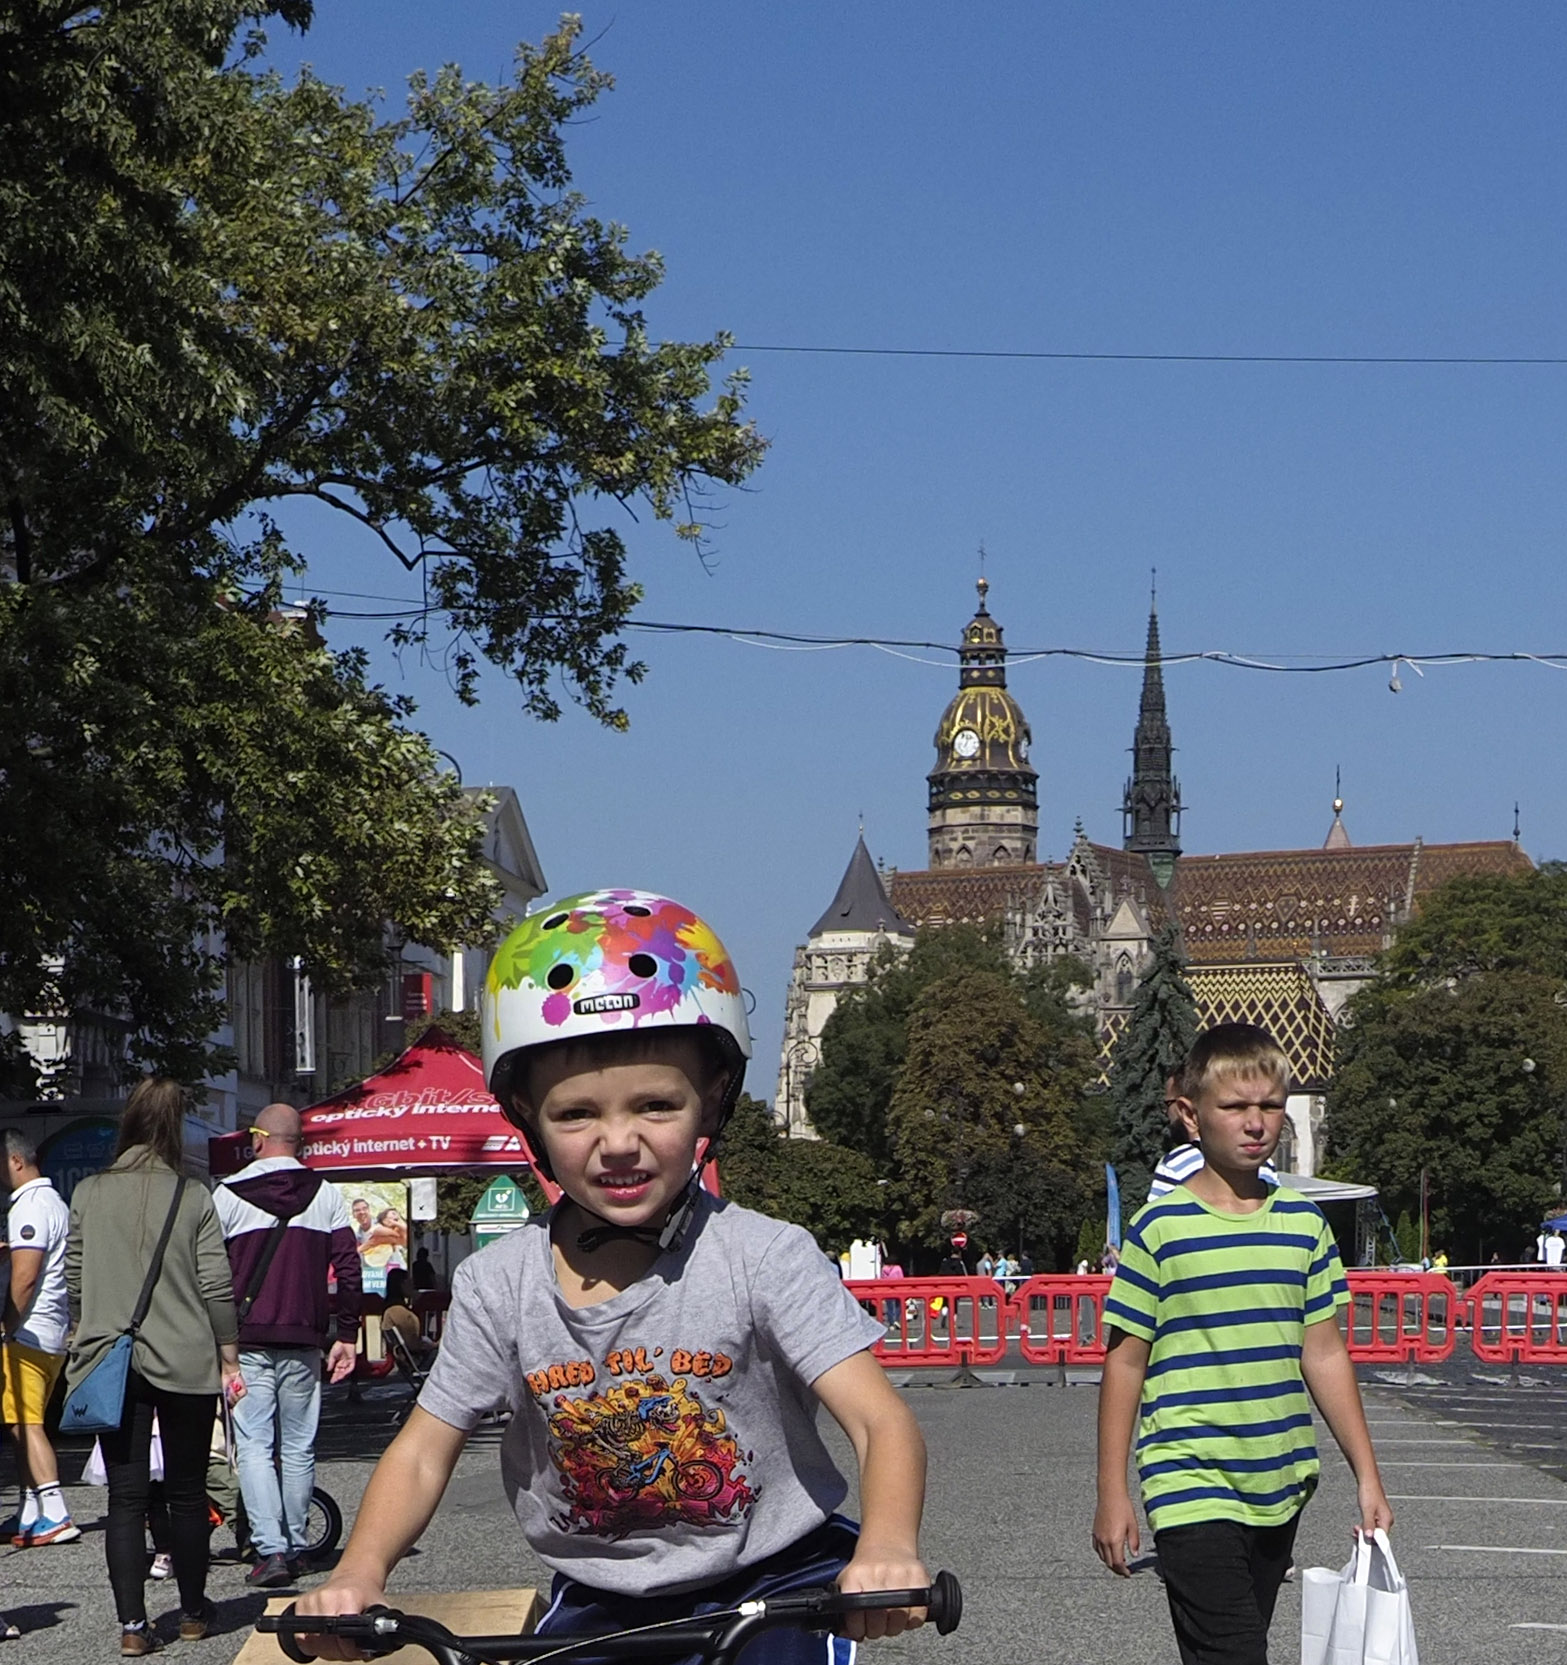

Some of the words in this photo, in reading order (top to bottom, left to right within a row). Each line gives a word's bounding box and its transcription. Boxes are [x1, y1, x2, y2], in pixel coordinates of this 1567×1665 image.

[310, 1102, 409, 1124] optický
[412, 1101, 503, 1116] interne
[353, 1136, 415, 1153] internet
[428, 1135, 451, 1150] TV
[526, 1360, 596, 1396] HRED
